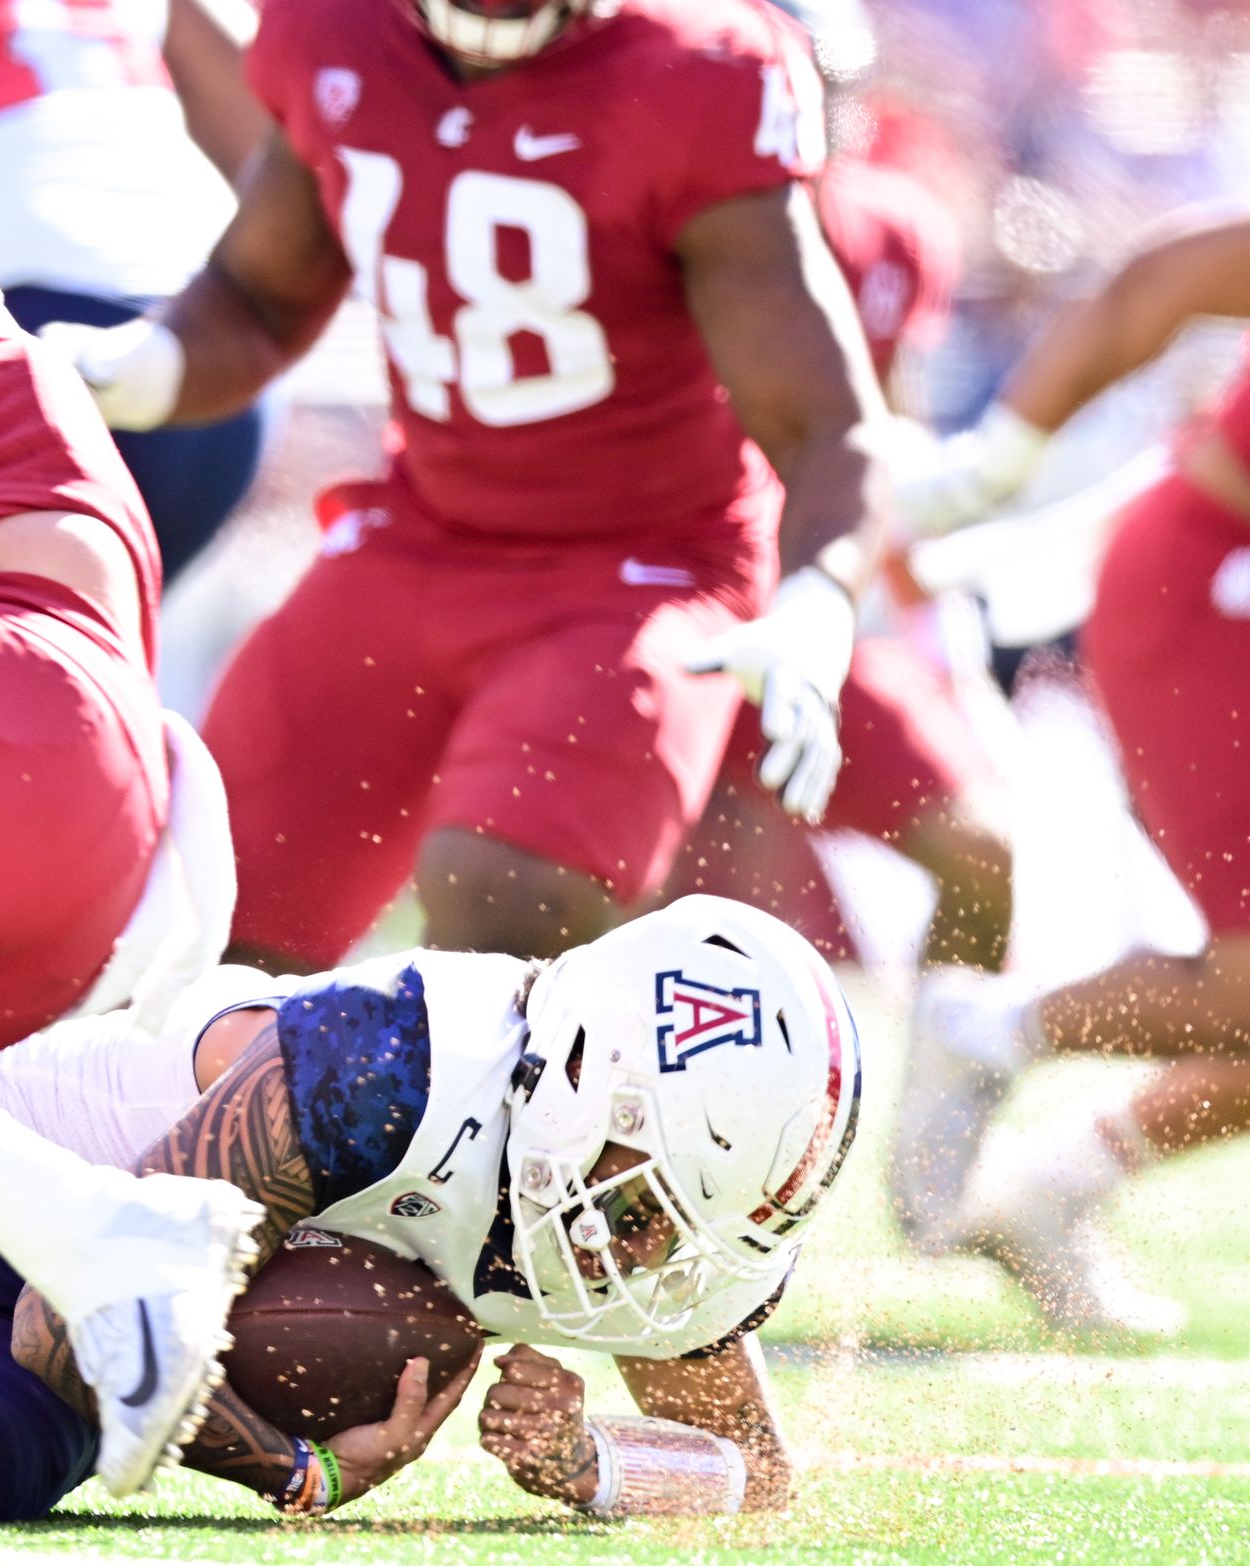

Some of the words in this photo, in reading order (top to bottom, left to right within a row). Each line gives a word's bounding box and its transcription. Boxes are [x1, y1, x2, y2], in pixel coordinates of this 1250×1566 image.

[333, 145, 616, 428] 48
[654, 968, 763, 1074] A
[427, 1116, 483, 1185] C
